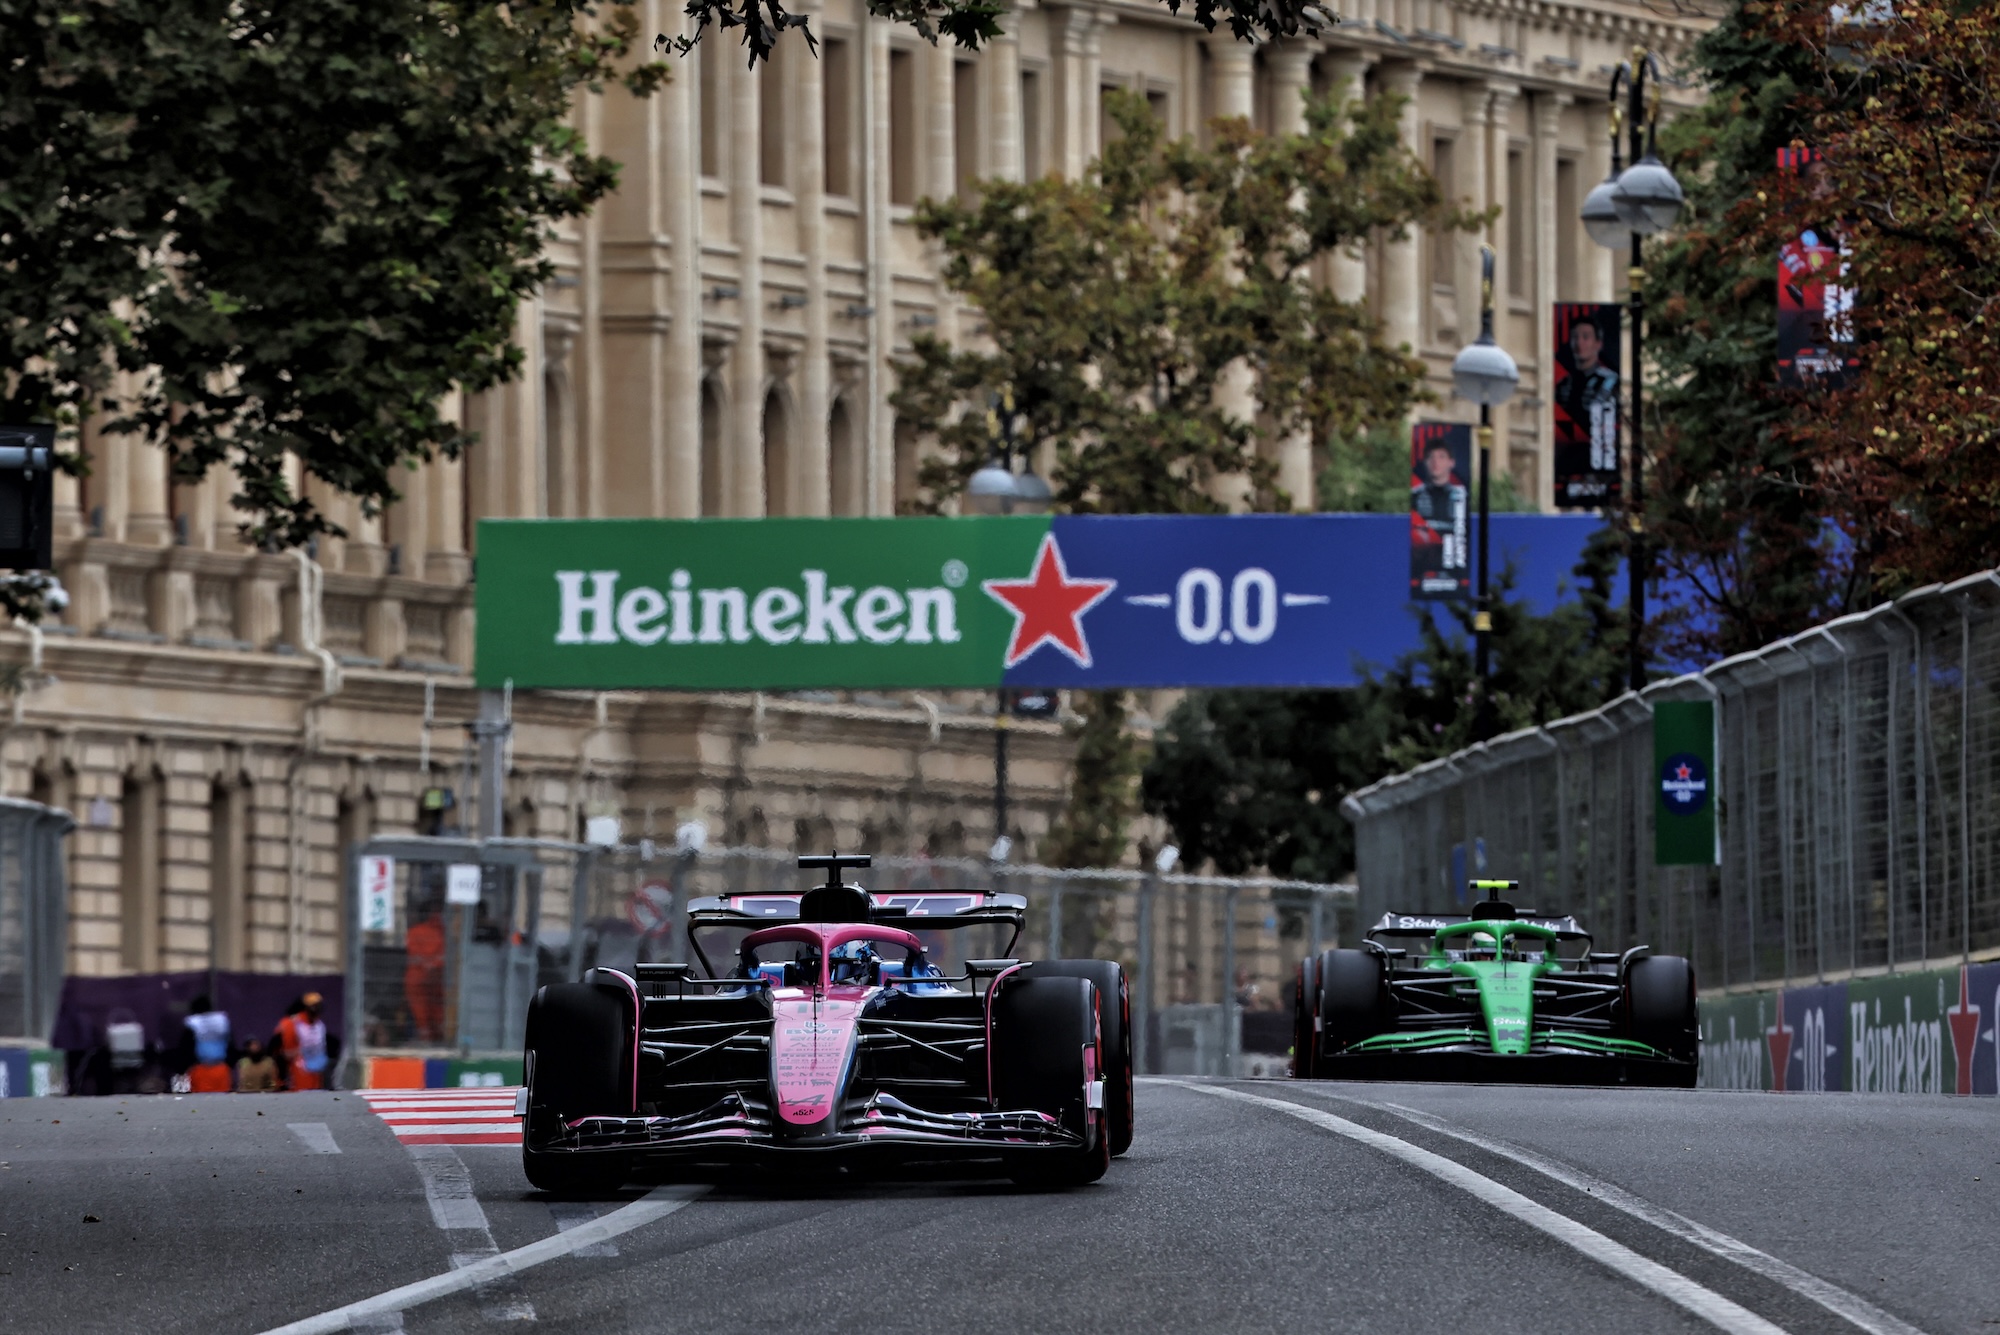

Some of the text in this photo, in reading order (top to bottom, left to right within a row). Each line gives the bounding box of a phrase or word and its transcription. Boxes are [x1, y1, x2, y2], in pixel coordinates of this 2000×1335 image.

[554, 568, 961, 645] Heineken
[1399, 916, 1447, 930] Stake
[785, 1028, 844, 1036] BWT
